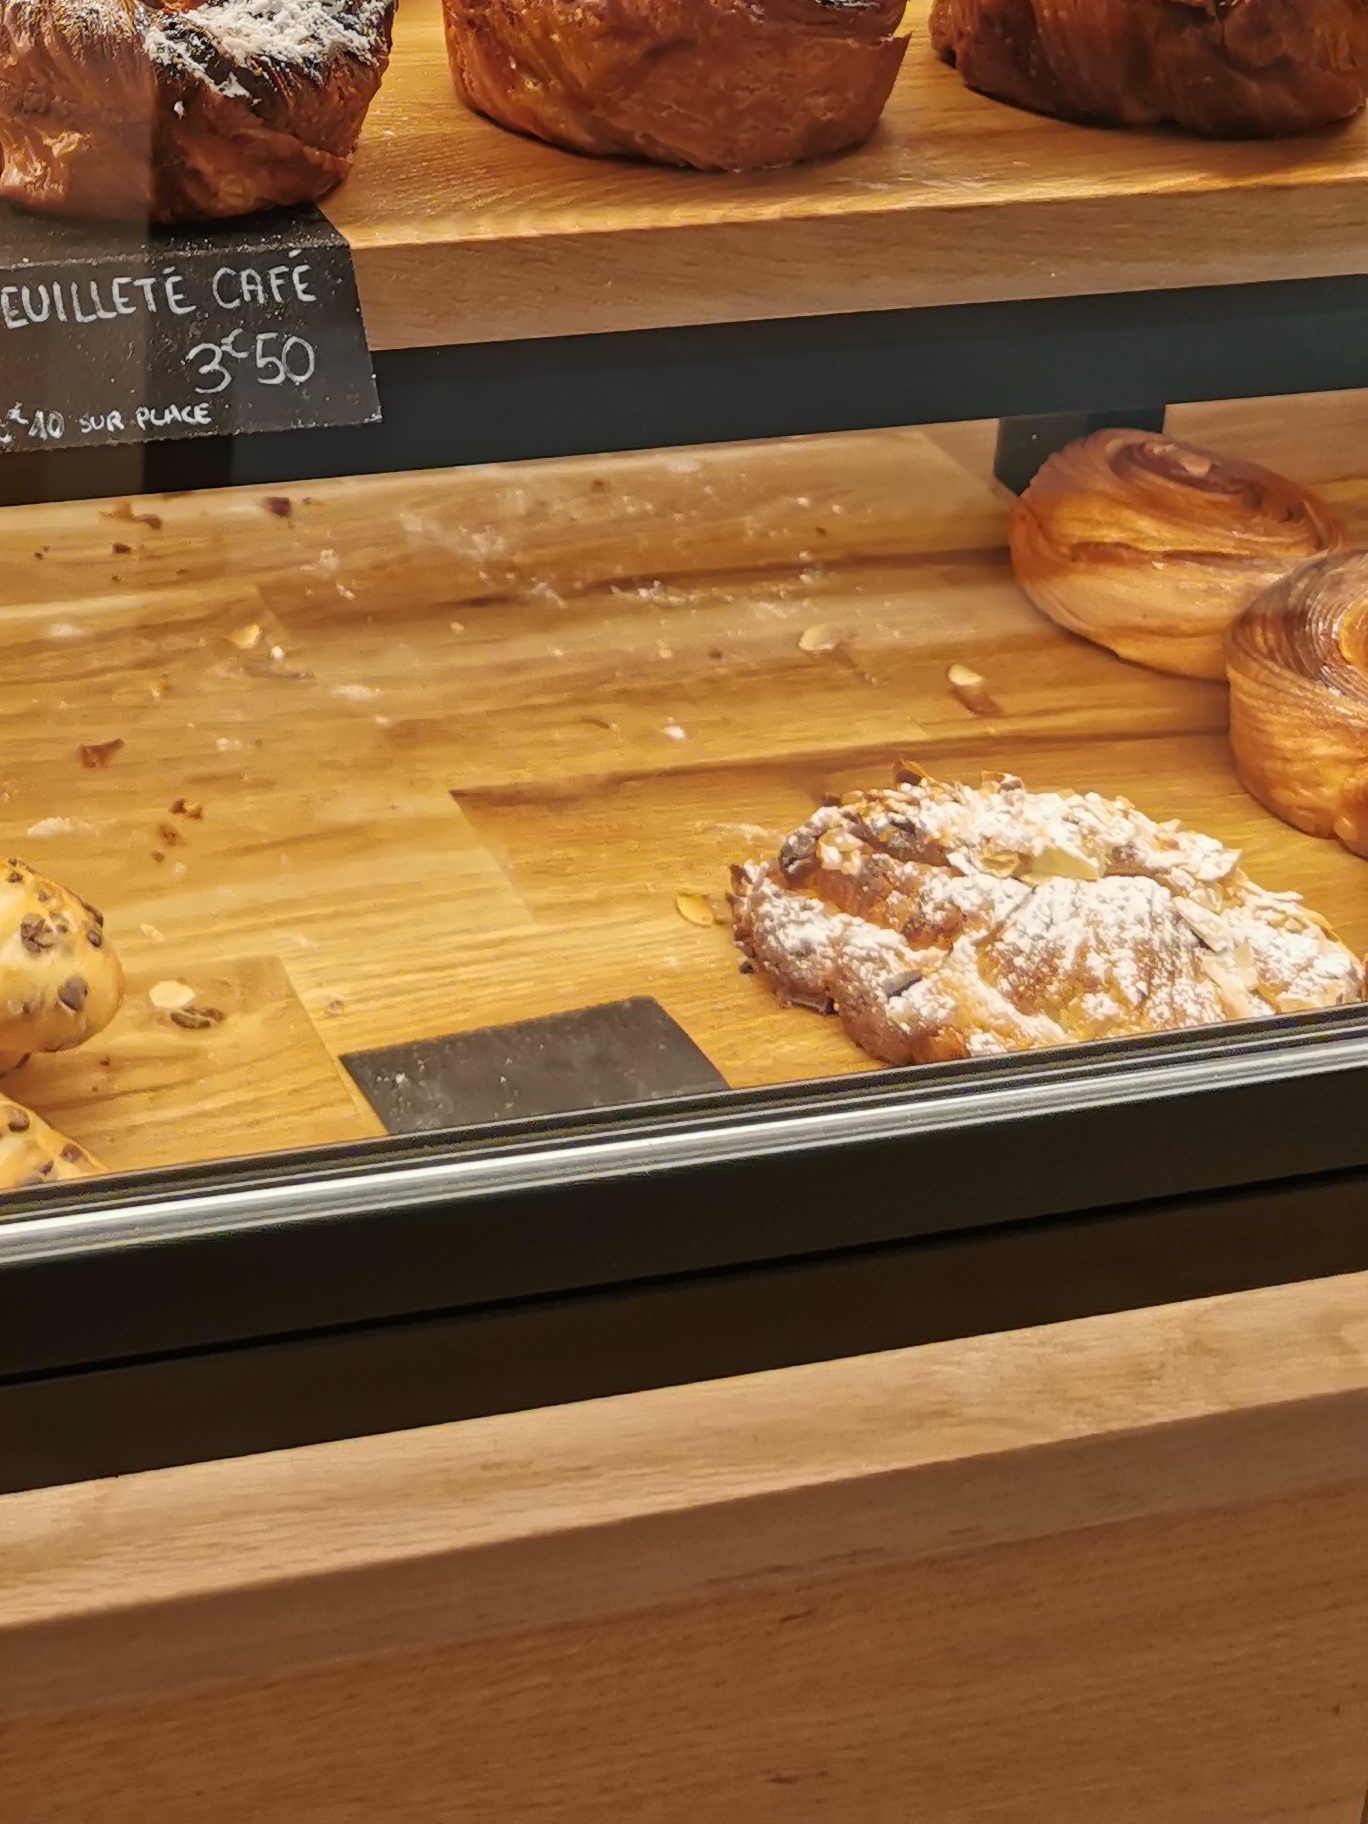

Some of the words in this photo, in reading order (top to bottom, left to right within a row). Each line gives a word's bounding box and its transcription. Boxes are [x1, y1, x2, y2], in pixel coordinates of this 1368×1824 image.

[212, 250, 318, 310] CAFÉ
[79, 409, 126, 434] SUR
[135, 402, 213, 431] PLACE
